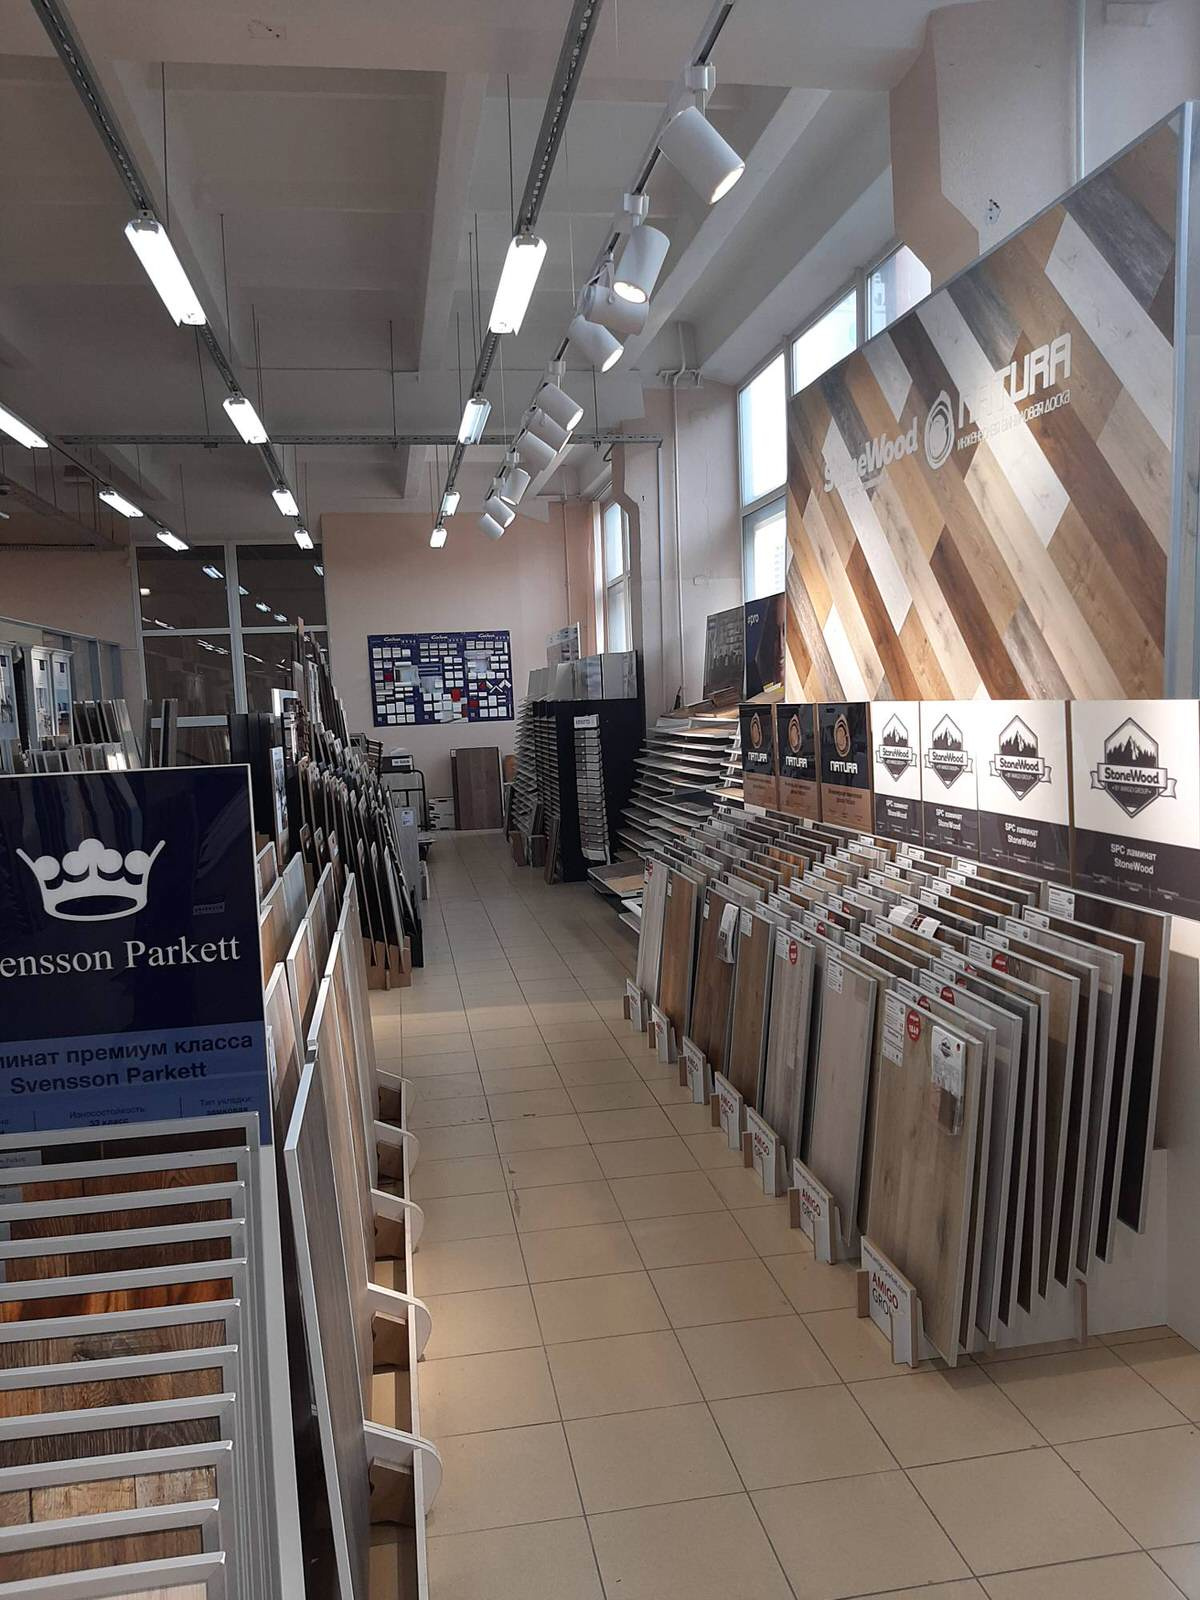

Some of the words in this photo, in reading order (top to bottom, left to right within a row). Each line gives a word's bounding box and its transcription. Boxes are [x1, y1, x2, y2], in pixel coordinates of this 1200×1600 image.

[824, 416, 918, 492] SneWood
[932, 751, 964, 763] StoneWood
[1000, 757, 1040, 772] StoneWood
[829, 760, 858, 774] NATURA
[1104, 767, 1160, 785] StoneWood
[1110, 843, 1126, 855] SPC
[1114, 857, 1154, 875] StoneWood
[123, 936, 241, 968] Parkett
[67, 1043, 168, 1067] премиум
[175, 1035, 253, 1054] класса
[10, 1073, 119, 1095] Svensson
[126, 1062, 208, 1084] Parkett
[872, 1272, 899, 1310] AMIGO
